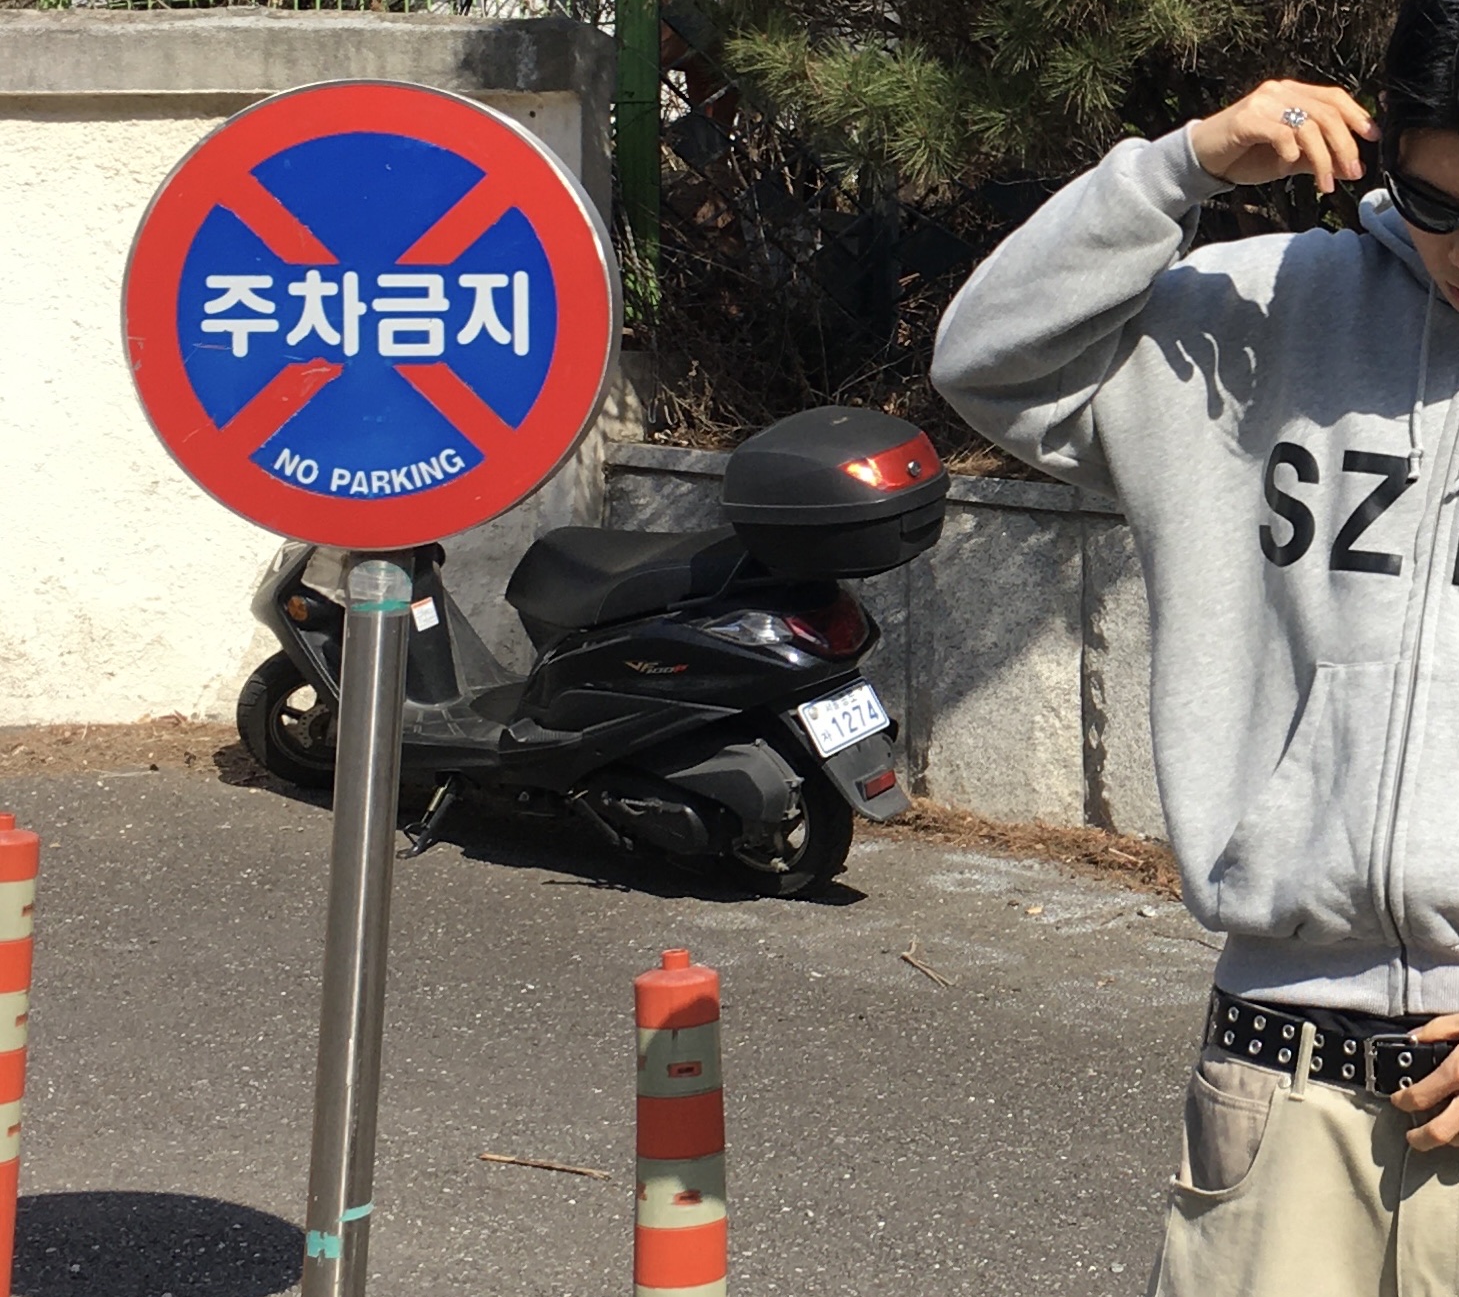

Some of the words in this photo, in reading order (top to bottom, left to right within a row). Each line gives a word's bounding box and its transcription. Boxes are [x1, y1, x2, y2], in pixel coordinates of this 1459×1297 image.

[201, 270, 530, 357] 주차금지
[274, 448, 319, 484] NO
[329, 448, 466, 495] PARKING
[831, 700, 879, 738] 1274
